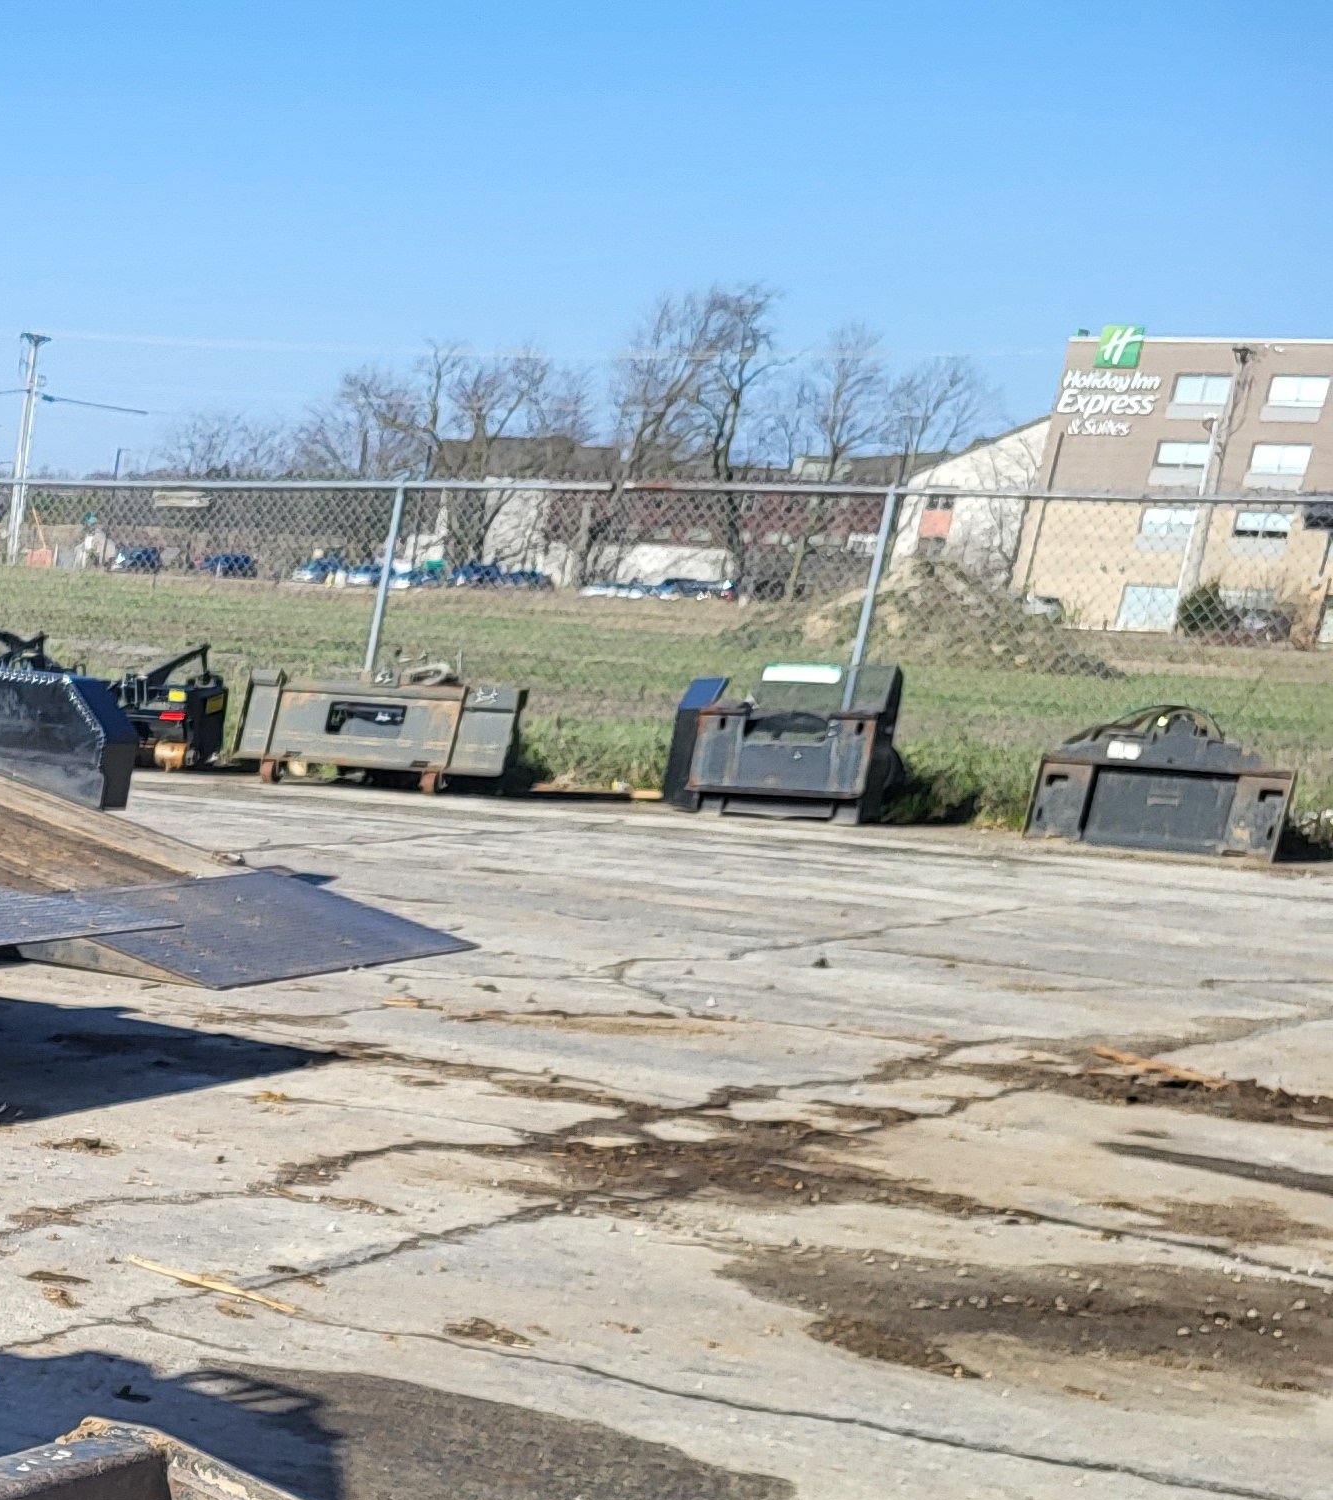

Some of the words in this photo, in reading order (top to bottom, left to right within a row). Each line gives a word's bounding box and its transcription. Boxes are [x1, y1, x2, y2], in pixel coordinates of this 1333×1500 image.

[1062, 369, 1131, 393] Holiday
[1131, 370, 1161, 390] Inn
[1056, 388, 1158, 419] Express
[1081, 418, 1131, 437] Suites
